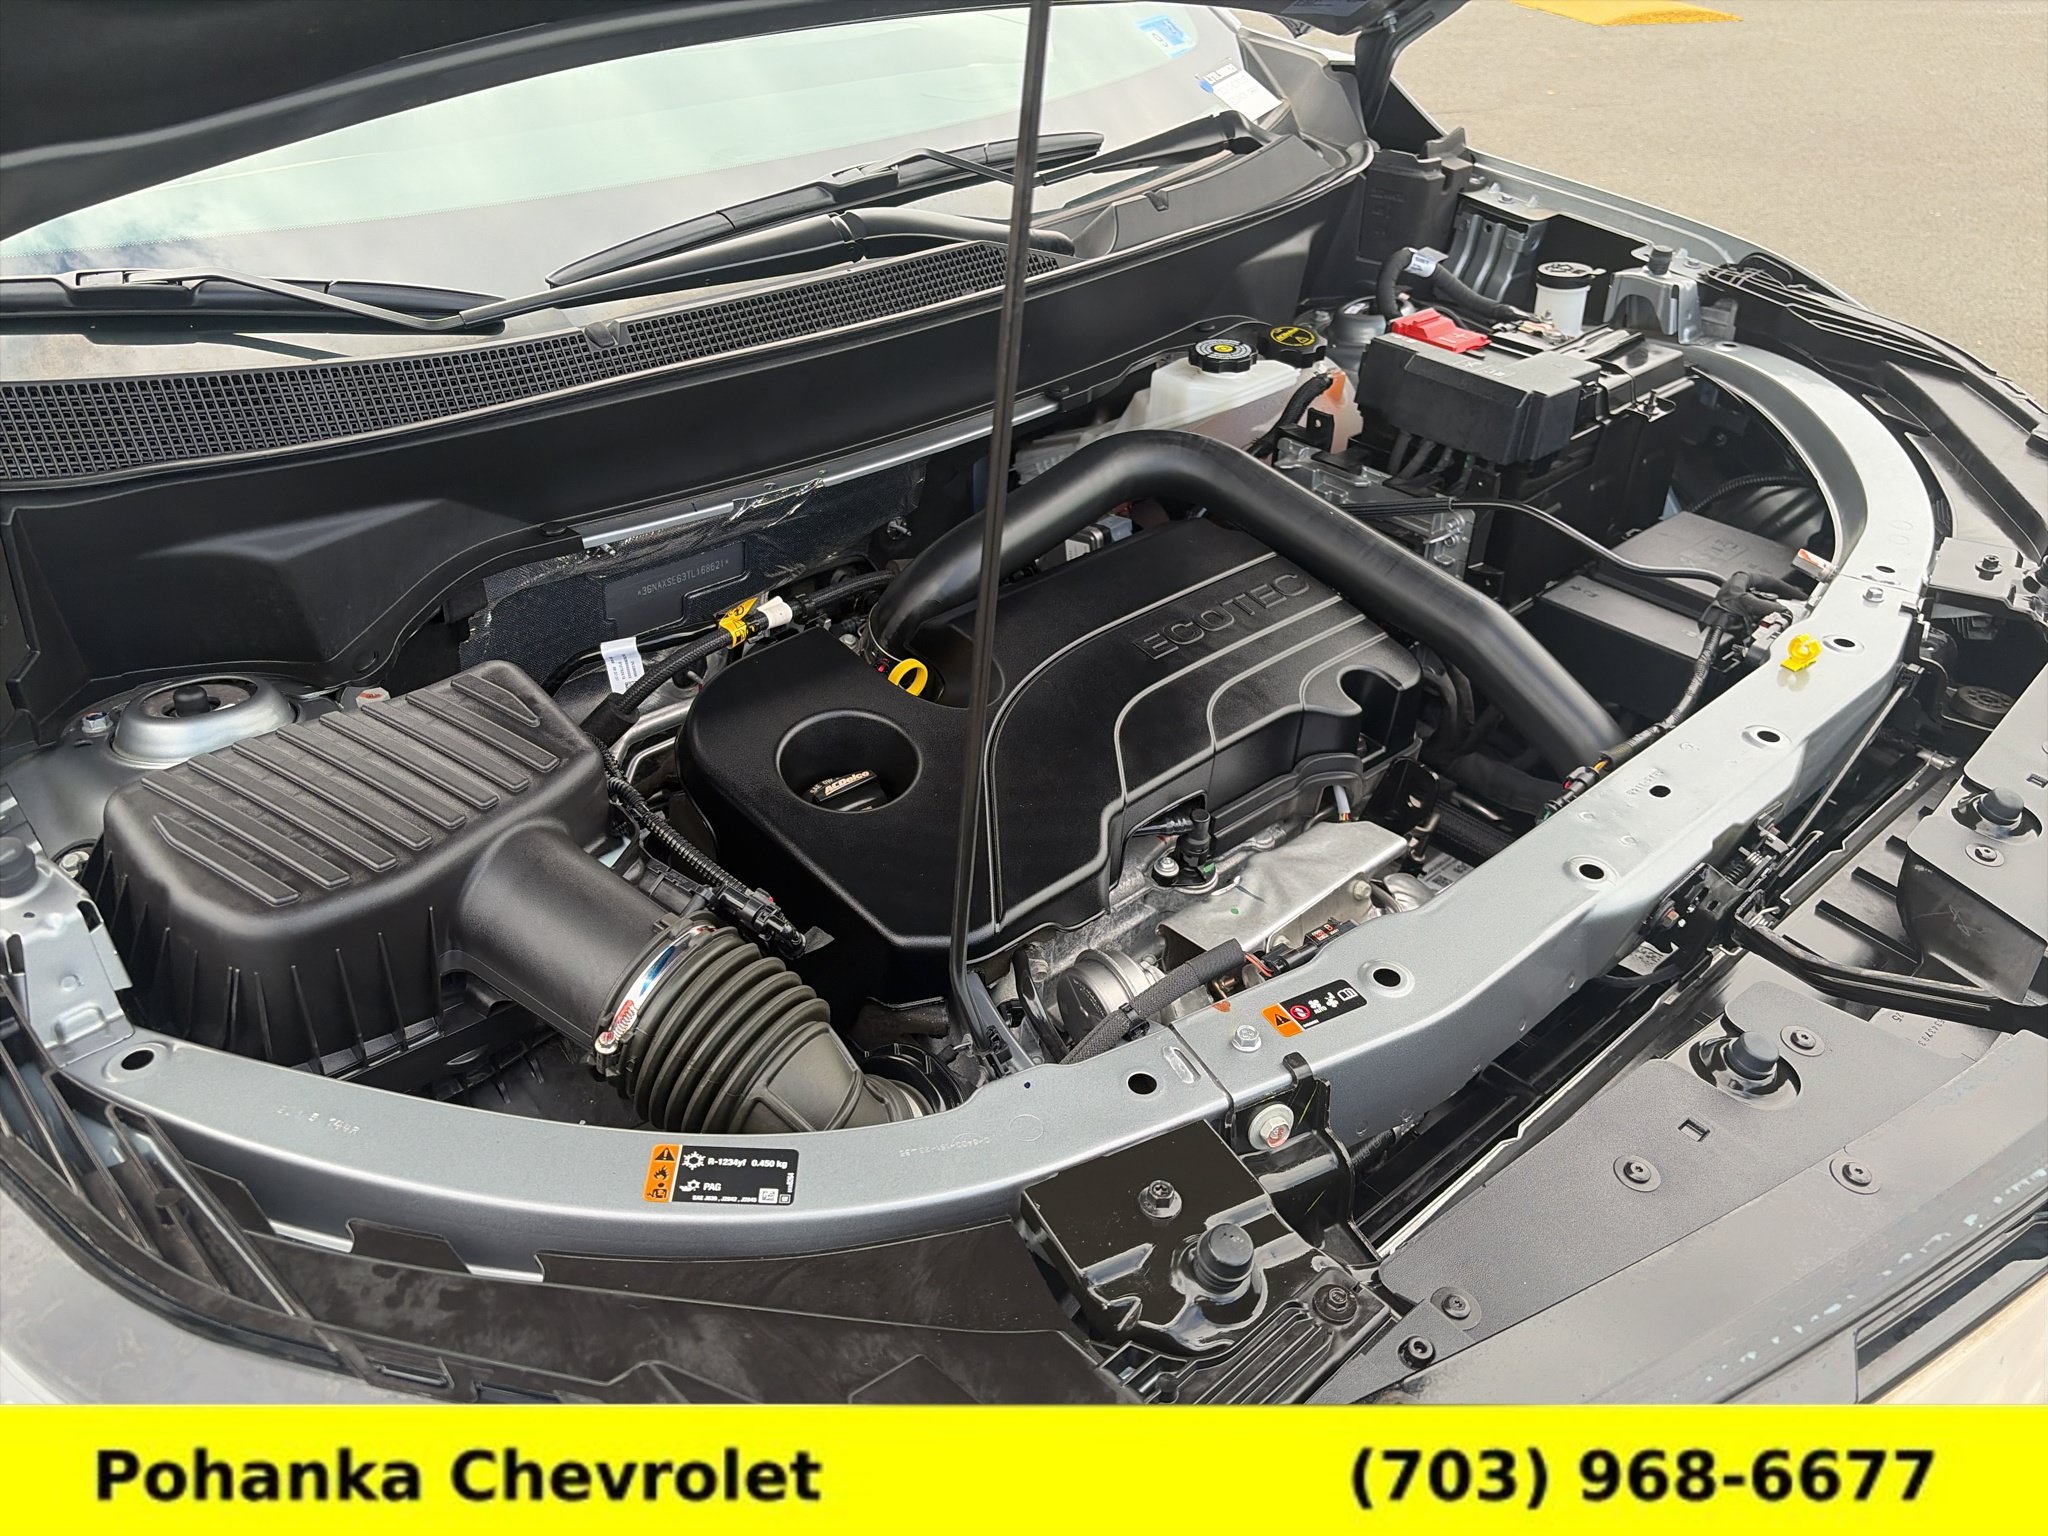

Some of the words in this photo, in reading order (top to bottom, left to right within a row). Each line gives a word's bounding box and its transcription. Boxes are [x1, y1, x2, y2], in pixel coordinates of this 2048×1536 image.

[1132, 574, 1310, 659] ECOTEC
[824, 771, 870, 796] ACDelco
[707, 1158, 747, 1168] R-1234yf
[751, 1159, 776, 1168] 0.450
[776, 1160, 788, 1169] kg
[702, 1182, 722, 1192] PAG
